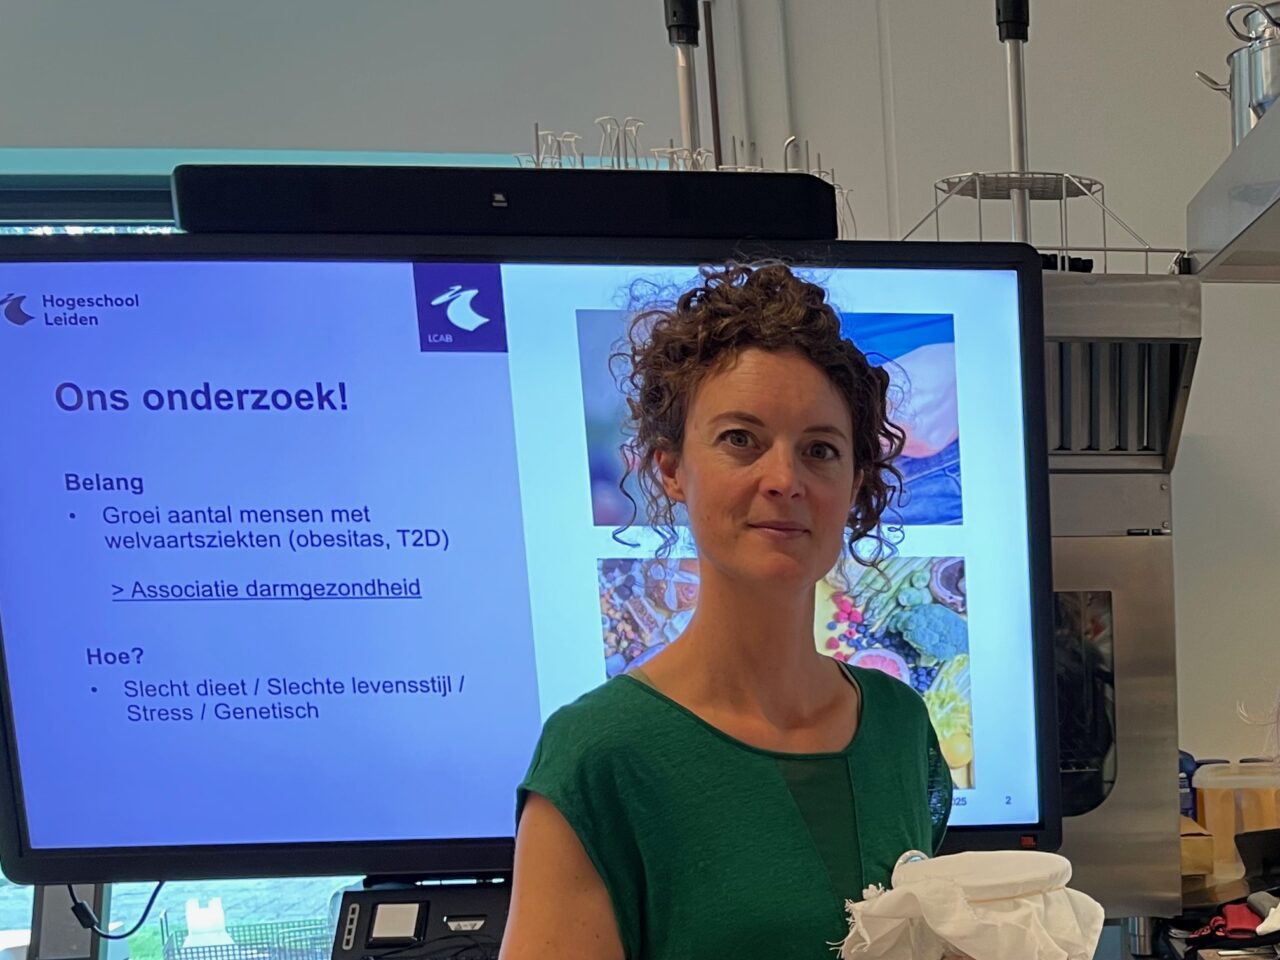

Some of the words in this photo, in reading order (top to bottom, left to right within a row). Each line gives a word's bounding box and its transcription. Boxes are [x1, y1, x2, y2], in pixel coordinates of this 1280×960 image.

[43, 294, 139, 310] Hogeschool
[45, 313, 98, 325] Leiden
[428, 334, 453, 343] LCAB
[56, 383, 129, 411] Ons
[143, 382, 347, 410] onderzoek!
[65, 474, 143, 494] Belang
[103, 506, 160, 524] Groei
[168, 506, 231, 523] aantal
[240, 510, 323, 523] mensen
[331, 506, 370, 522] met
[105, 531, 280, 548] welvaartsziekten
[289, 530, 389, 552] (obesitas,
[397, 530, 448, 550] T2D)
[131, 580, 239, 598] Associatie
[246, 578, 421, 600] darmgezondheid
[87, 648, 143, 664] Hoe?
[125, 680, 189, 697] Slecht
[197, 679, 247, 696] dieet
[268, 678, 344, 695] Slechte
[352, 676, 451, 697] levensstijl
[128, 705, 193, 721] Stress
[215, 702, 318, 719] Genetisch
[1005, 796, 1012, 805] 2
